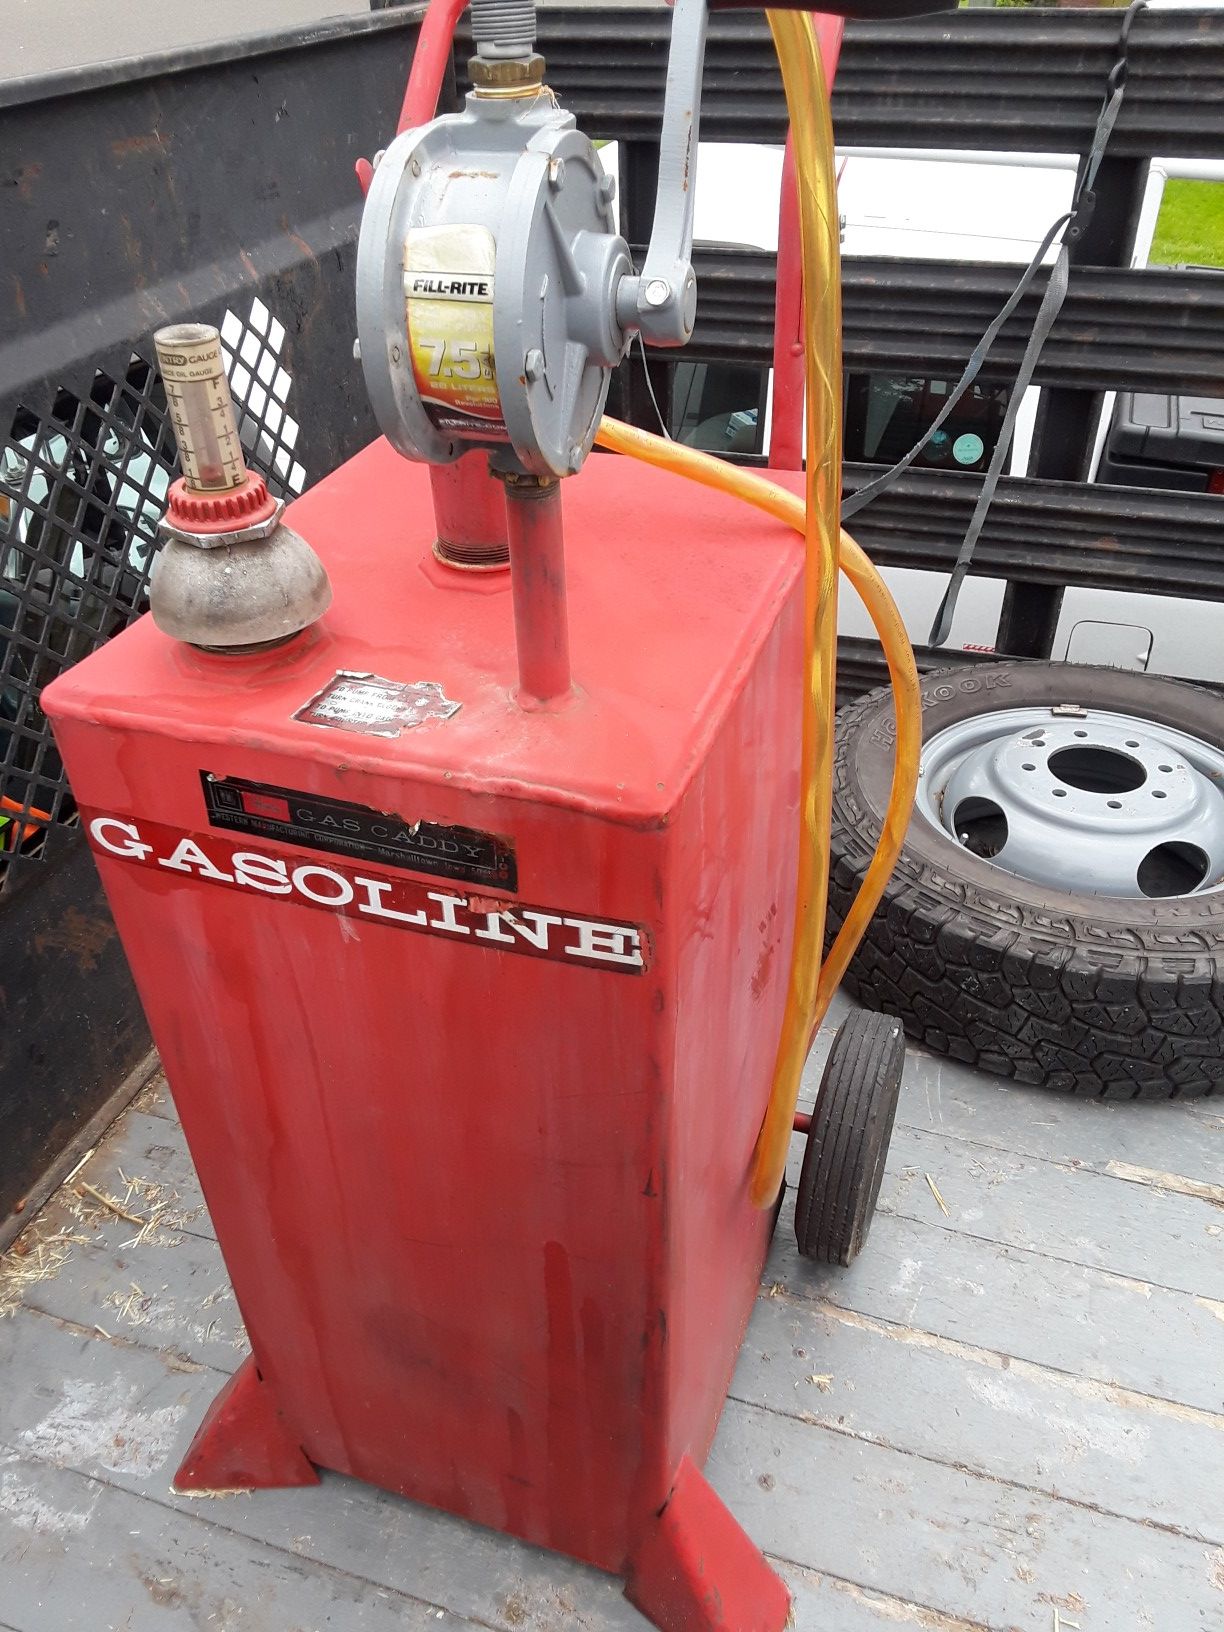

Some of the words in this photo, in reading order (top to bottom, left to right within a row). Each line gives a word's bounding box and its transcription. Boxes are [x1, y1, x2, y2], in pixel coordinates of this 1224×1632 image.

[413, 279, 489, 296] FILL-RITE
[188, 350, 218, 364] GAUGE
[418, 338, 481, 380] 7.5
[189, 369, 213, 377] GAUGE
[327, 693, 347, 701] TURN
[347, 687, 369, 696] PUMP
[329, 706, 350, 715] PUMP
[213, 811, 249, 825] WESTERN
[250, 819, 312, 840] MANUFACTURING
[296, 808, 361, 832] GAS
[370, 824, 486, 858] CADDY
[89, 817, 643, 967] GASOLINE
